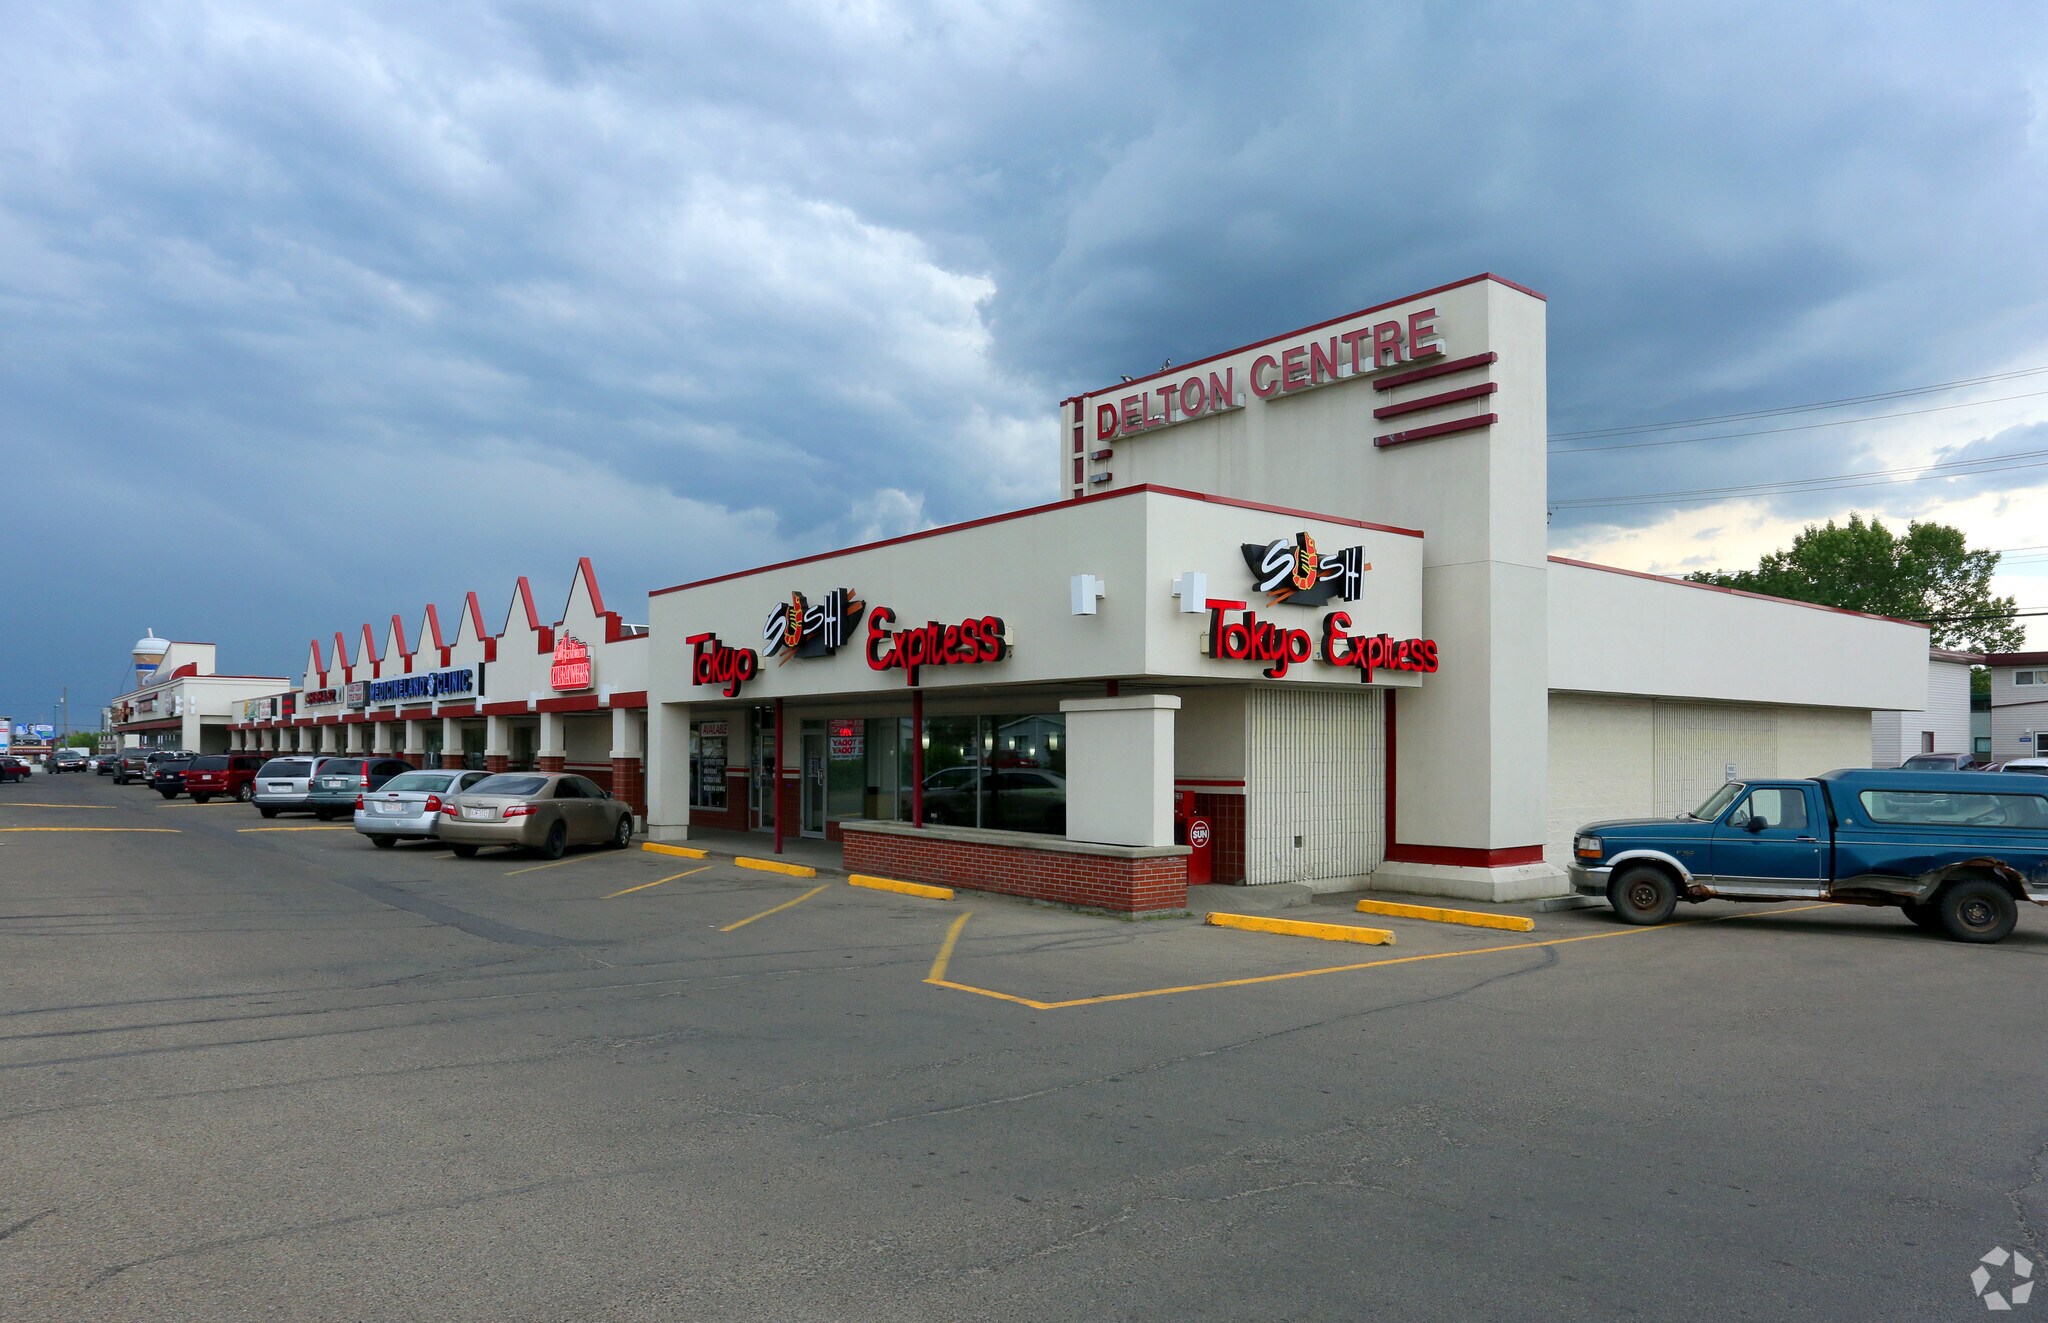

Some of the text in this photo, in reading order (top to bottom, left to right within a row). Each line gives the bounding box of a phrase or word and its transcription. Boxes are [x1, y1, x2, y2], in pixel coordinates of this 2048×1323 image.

[1097, 307, 1440, 441] DELTON CENTRE
[686, 632, 758, 698] Tokyo
[866, 606, 1006, 686] Express
[1205, 598, 1439, 683] Tokyo Express
[370, 675, 429, 702] MEDICINELAND
[437, 669, 473, 694] CLINIC
[703, 723, 728, 735] AVAILABLE
[1192, 829, 1208, 839] SUN
